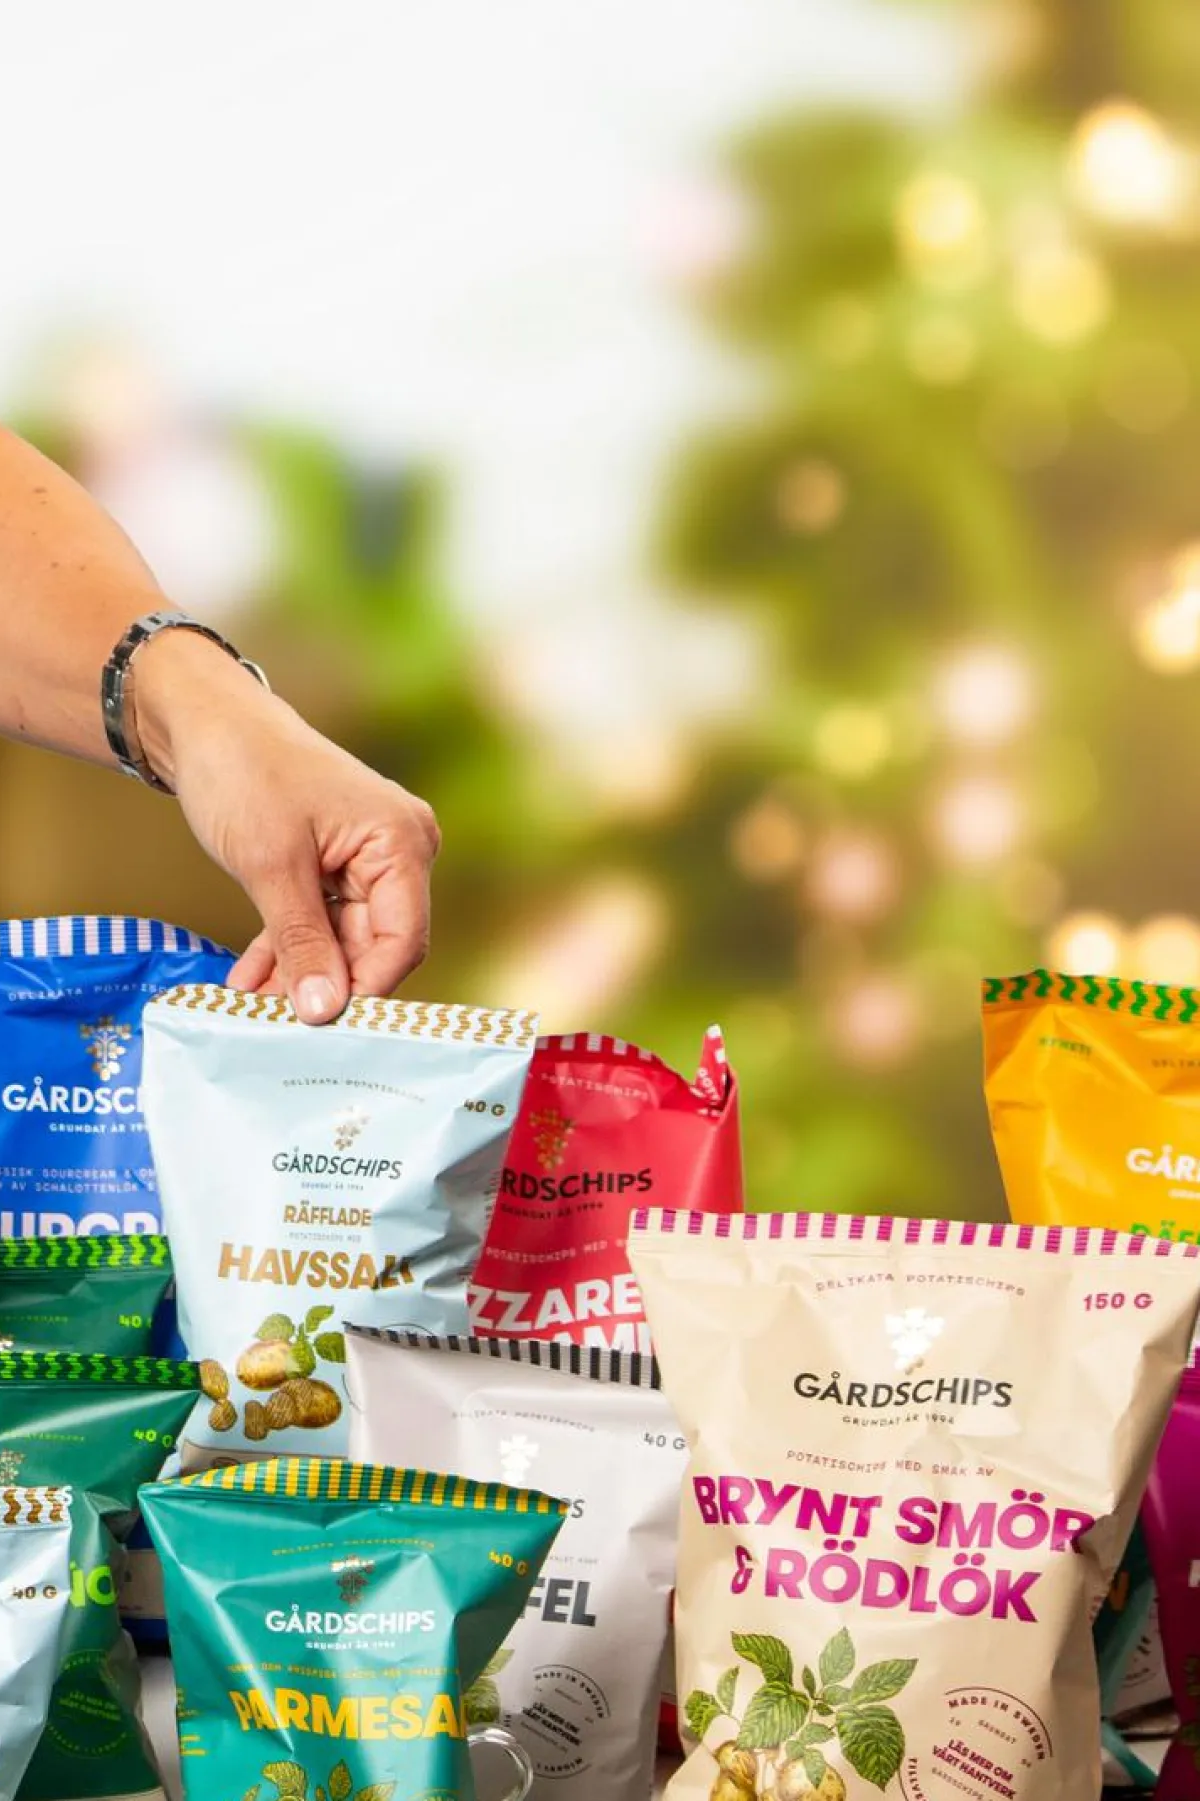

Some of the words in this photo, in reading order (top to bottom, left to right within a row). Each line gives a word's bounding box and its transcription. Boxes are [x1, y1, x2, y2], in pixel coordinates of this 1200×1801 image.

[2, 1076, 144, 1115] GÅRDSC
[464, 1098, 487, 1113] 40
[491, 1103, 506, 1116] G
[272, 1145, 403, 1180] GÅRDSCHIPS
[500, 1168, 653, 1201] RDSCHIPS
[283, 1200, 372, 1227] RÄFFLADE
[816, 1273, 895, 1292] DELIKATA
[906, 1274, 1025, 1296] POTATISCHIPS
[466, 1273, 642, 1331] ZZARE
[1082, 1292, 1125, 1312] 150
[1133, 1292, 1154, 1309] G
[118, 1314, 142, 1328] 40
[793, 1371, 1013, 1408] GÅRDSCHIPS
[134, 1428, 157, 1442] 40
[644, 1432, 666, 1448] 40
[673, 1437, 686, 1450] G
[895, 1460, 922, 1472] MED
[932, 1464, 968, 1476] SMAK
[976, 1467, 995, 1477] AV
[693, 1475, 882, 1539] BRYNT
[895, 1488, 1097, 1553] SMÖR
[489, 1550, 513, 1568] 40
[12, 1586, 36, 1599] 40
[43, 1585, 57, 1599] G
[730, 1544, 754, 1595] &
[764, 1539, 1042, 1623] RÖDLÖK
[265, 1603, 435, 1635] GÅRDSCHIPS
[948, 1696, 988, 1709] MADE
[993, 1700, 1009, 1712] IN
[1013, 1710, 1045, 1761] SWEDEN
[932, 1744, 960, 1767] VÅRT
[959, 1761, 1017, 1800] HANTVERK
[948, 1739, 969, 1757] LÄS
[969, 1751, 994, 1771] MER
[993, 1766, 1014, 1781] OM
